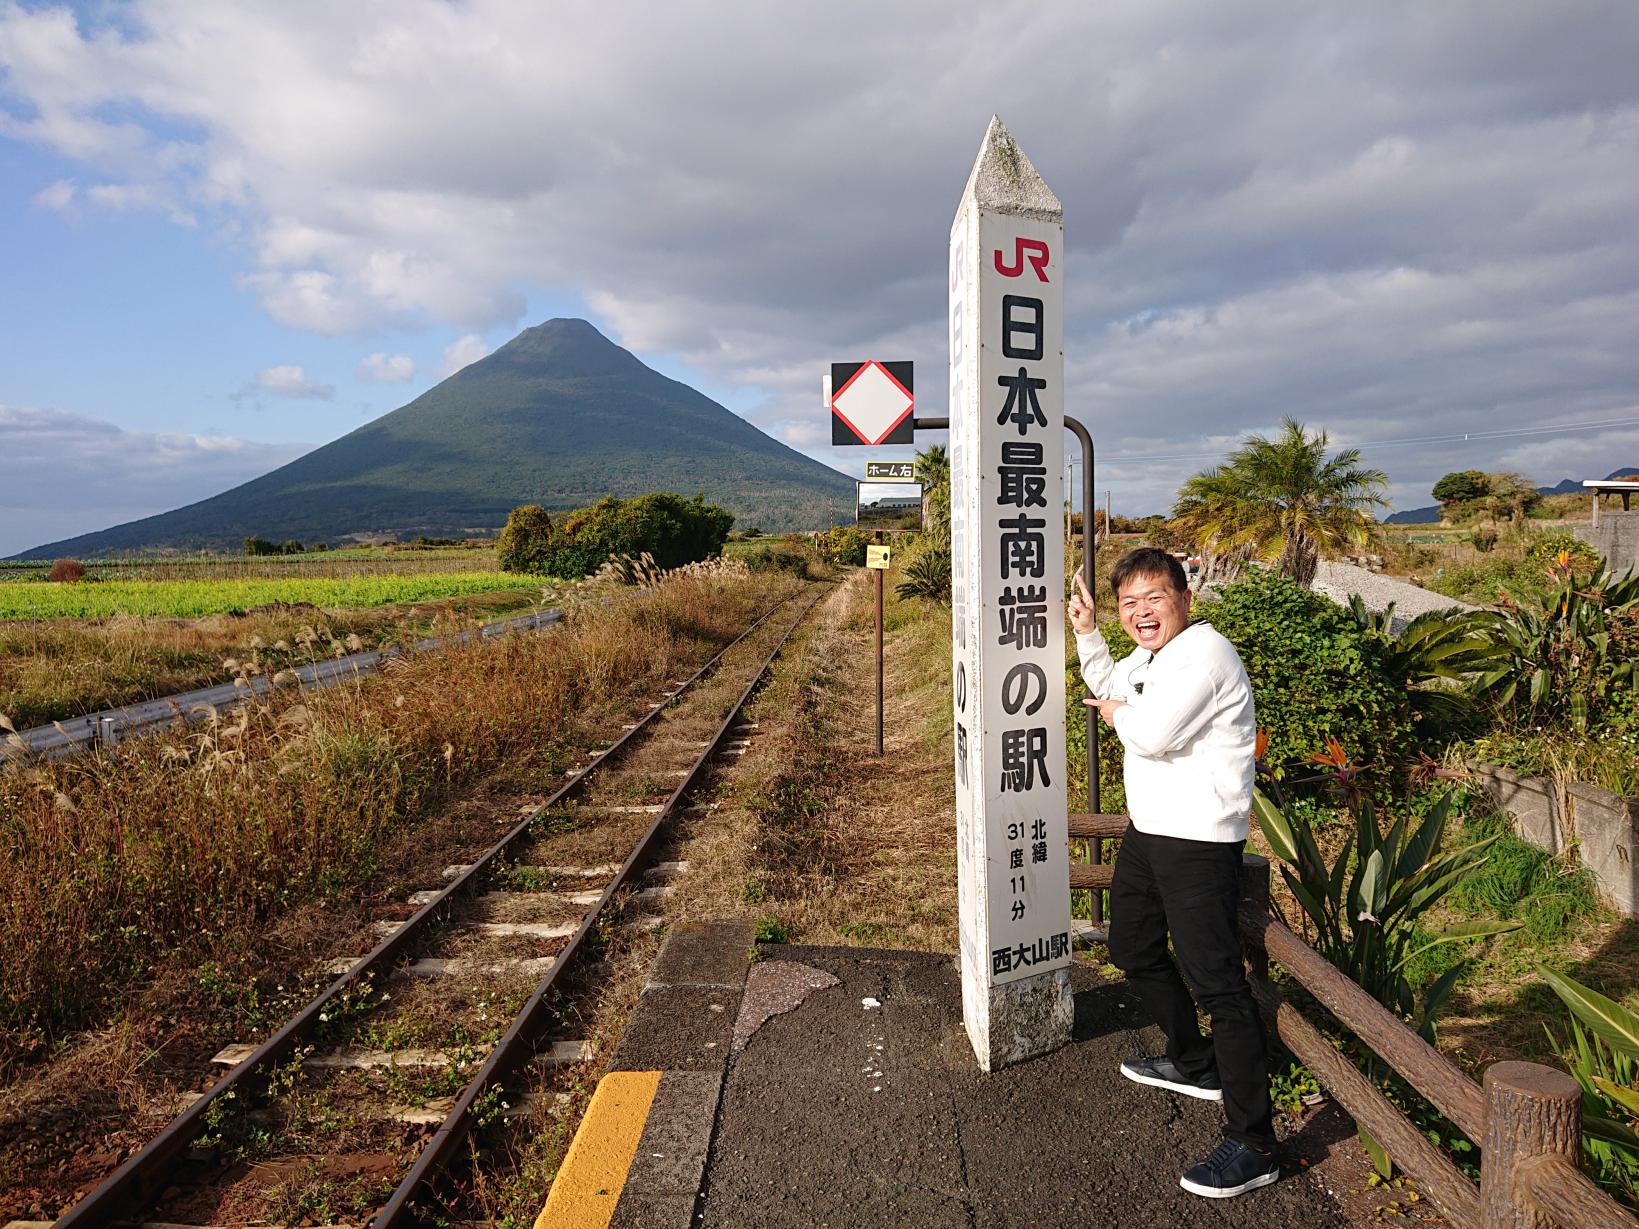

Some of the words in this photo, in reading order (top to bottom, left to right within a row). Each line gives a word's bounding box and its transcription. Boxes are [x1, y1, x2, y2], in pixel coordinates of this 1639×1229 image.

[952, 241, 964, 293] JR
[994, 237, 1050, 283] JR
[868, 464, 913, 477] ホーム右
[997, 294, 1050, 792] 日本最南端の駅
[1031, 819, 1048, 864] 北緯
[1007, 822, 1026, 921] 31度11分
[992, 932, 1069, 976] 西大山駅
